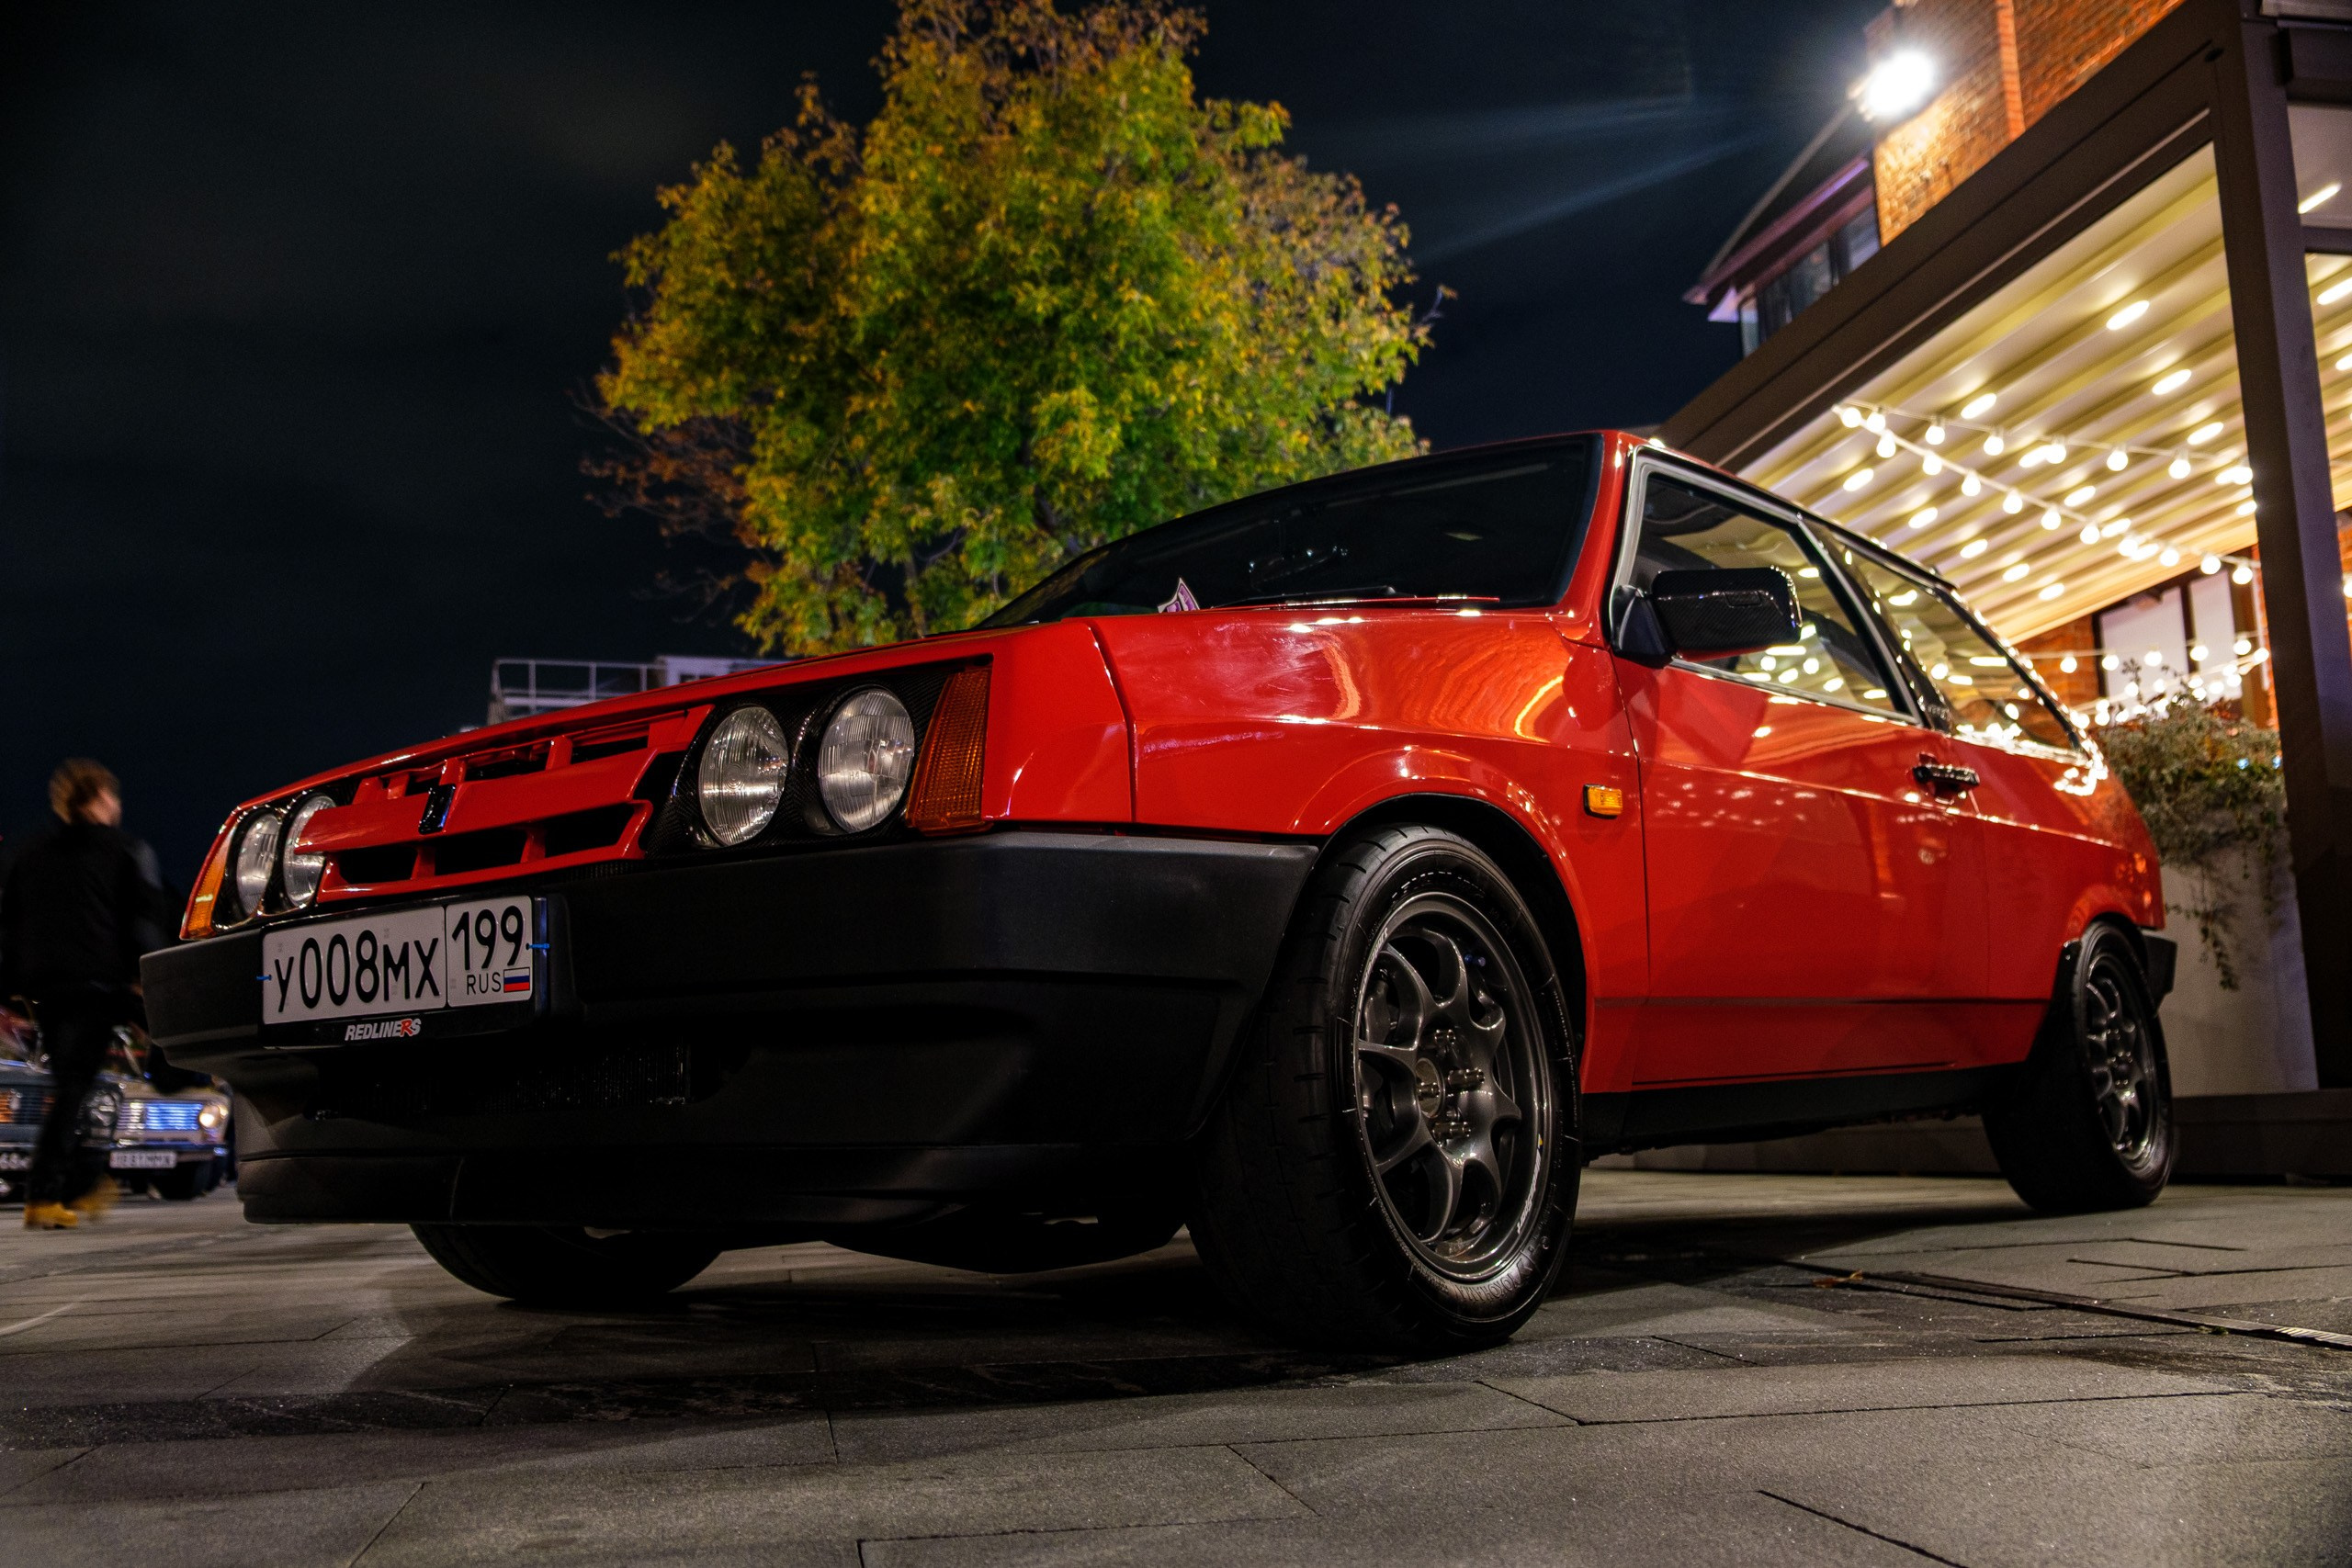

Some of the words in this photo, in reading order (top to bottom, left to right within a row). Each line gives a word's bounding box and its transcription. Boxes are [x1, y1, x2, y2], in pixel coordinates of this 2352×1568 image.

[452, 906, 525, 970] 199
[467, 972, 502, 995] RUS
[345, 1018, 422, 1042] REDLINERS
